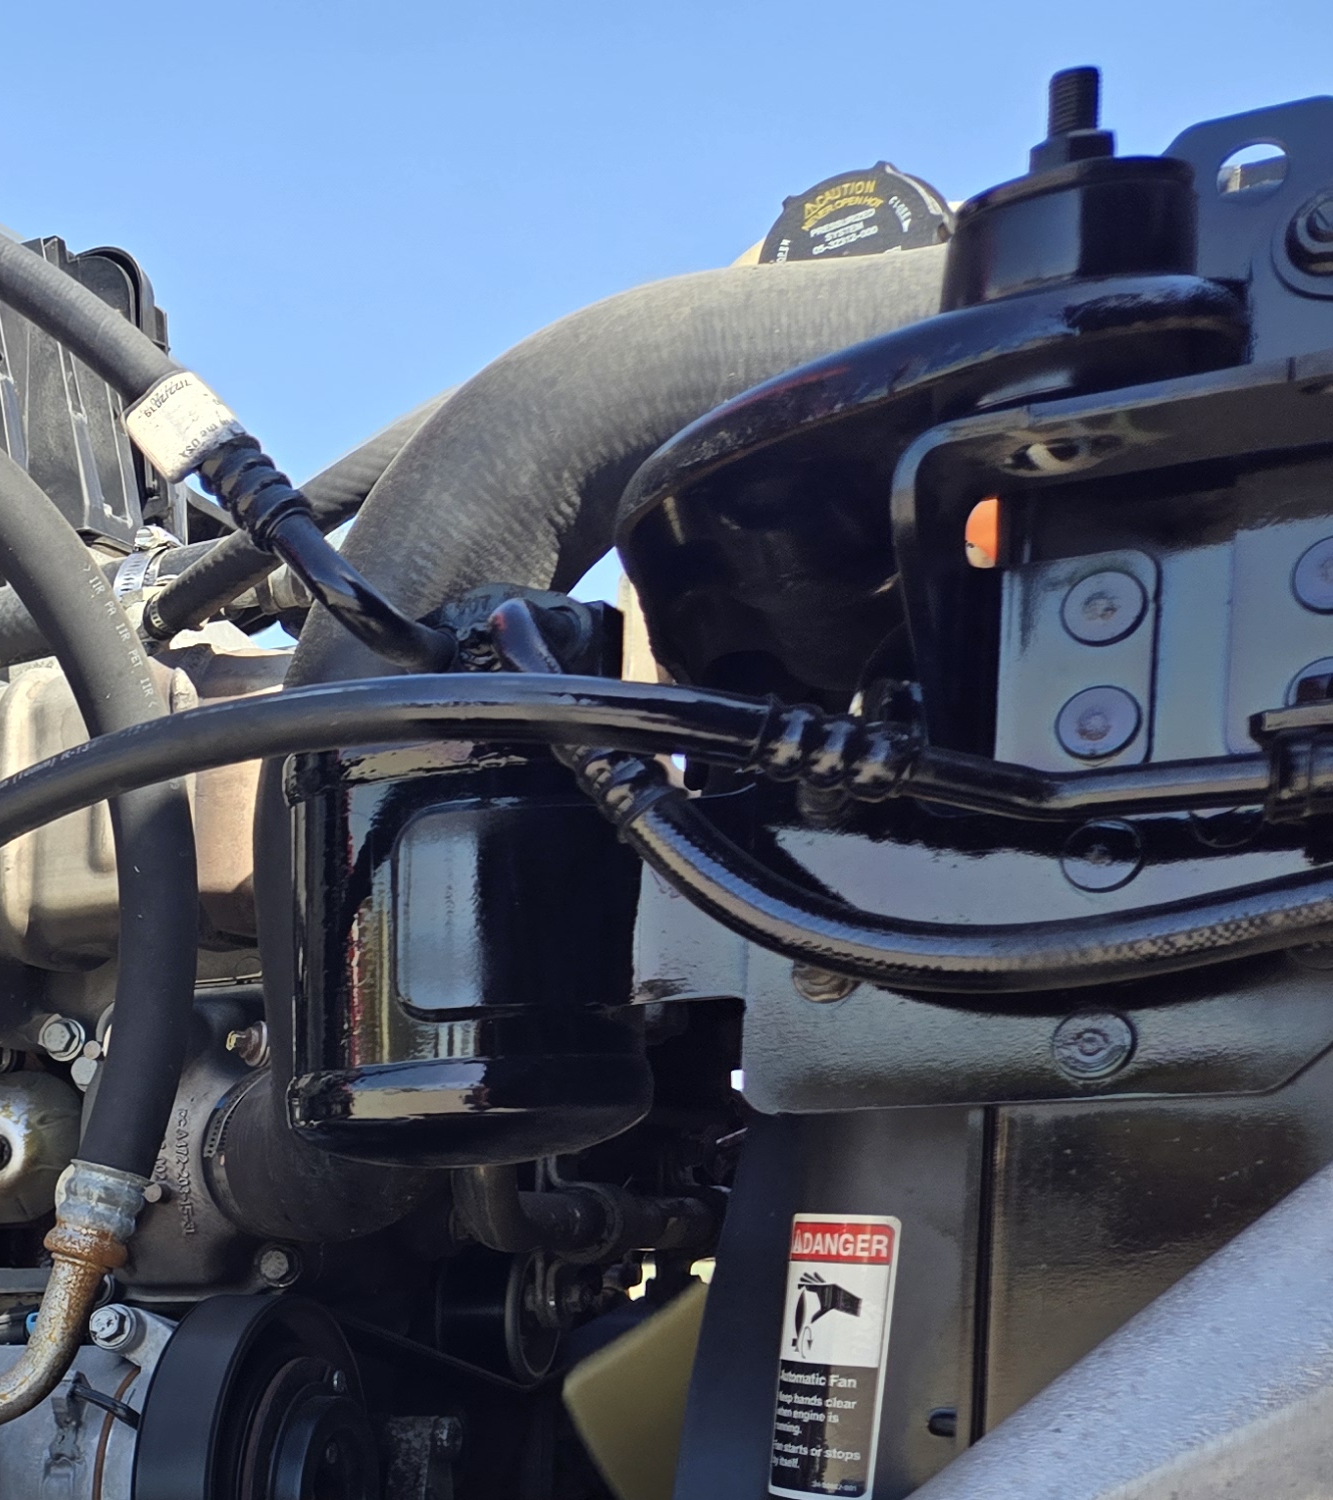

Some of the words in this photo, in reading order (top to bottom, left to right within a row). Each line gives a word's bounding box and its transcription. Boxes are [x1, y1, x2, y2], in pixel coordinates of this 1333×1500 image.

[815, 180, 878, 207] CAUTION
[801, 204, 834, 232] NEVER
[832, 197, 861, 212] OPEN
[860, 196, 884, 209] HOT
[128, 649, 143, 668] PET
[804, 1232, 889, 1258] DANGER
[829, 1374, 857, 1389] Fan
[825, 1397, 857, 1410] clear
[793, 1409, 825, 1423] engine
[828, 1411, 839, 1424] is
[810, 1446, 821, 1457] or
[824, 1446, 861, 1462] stops
